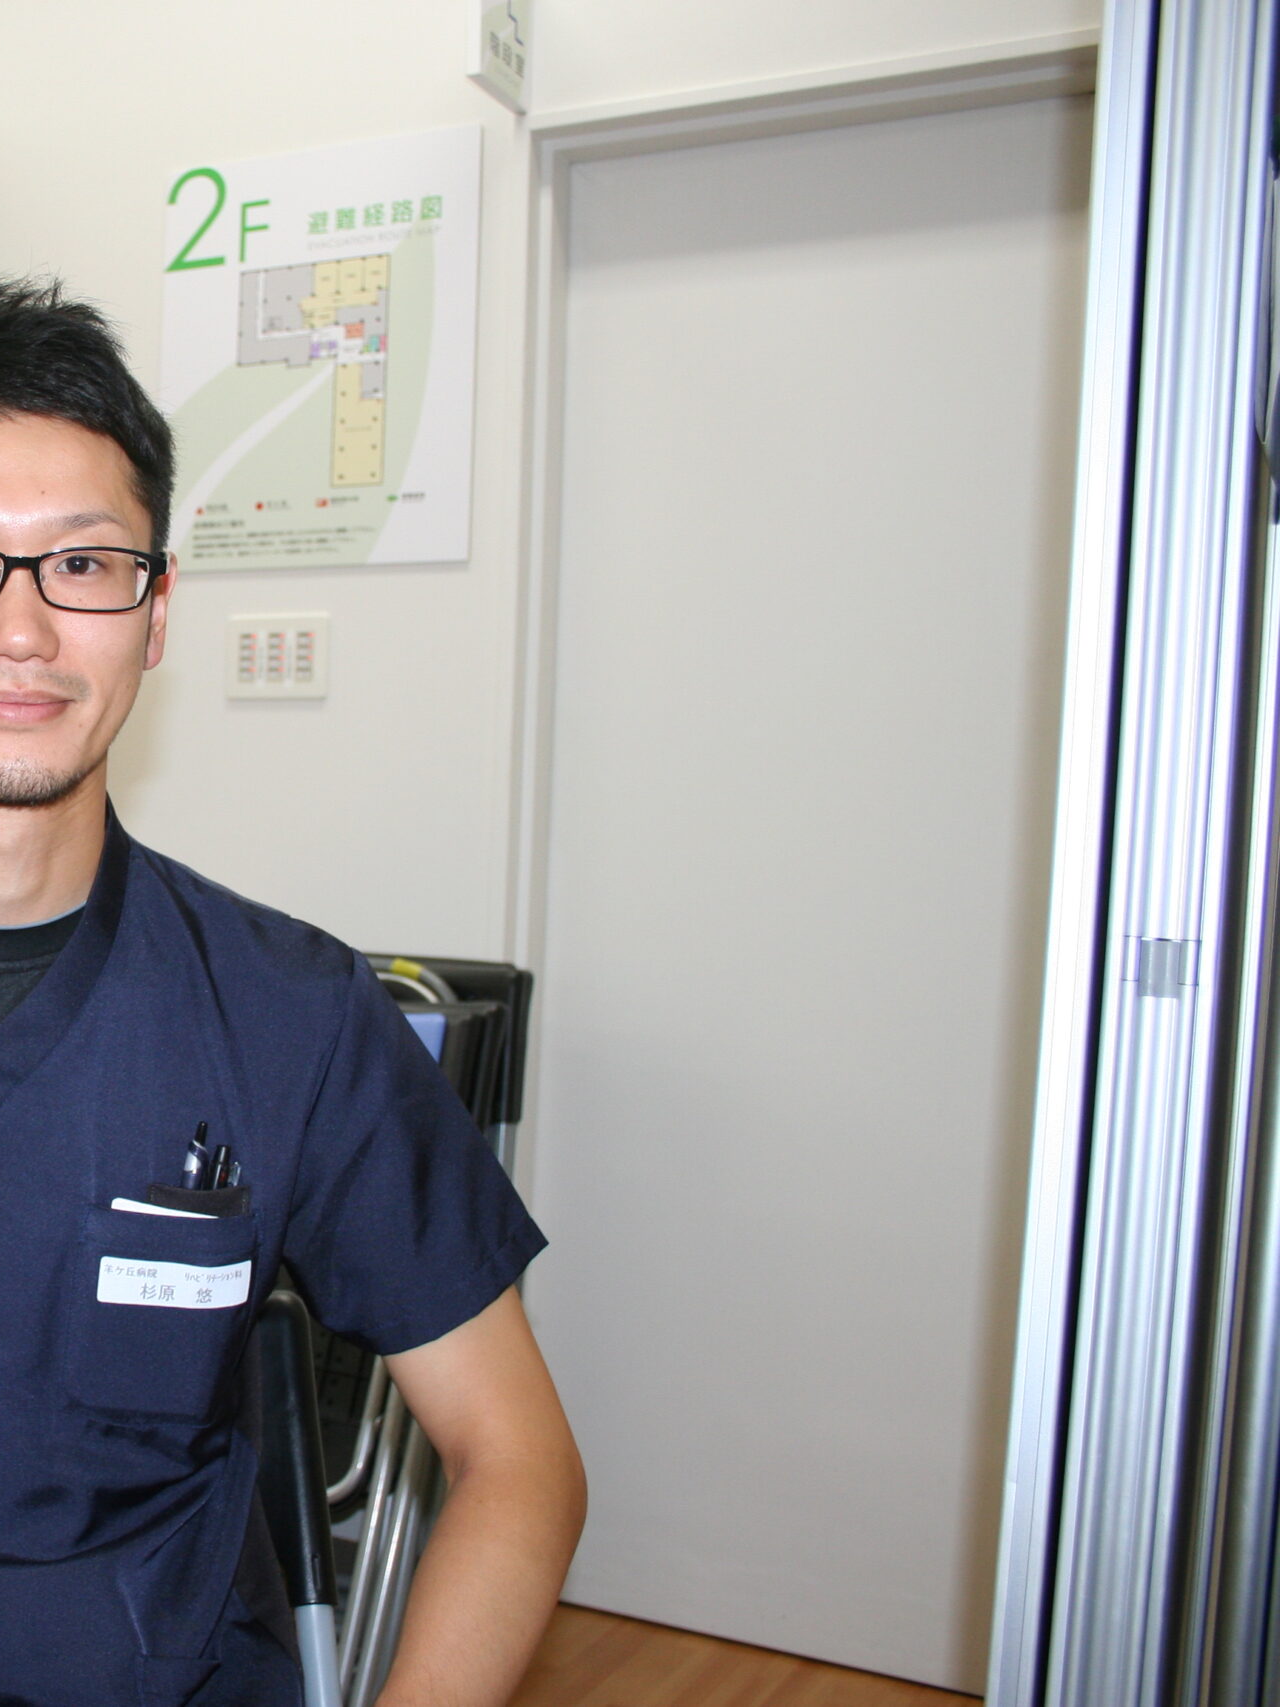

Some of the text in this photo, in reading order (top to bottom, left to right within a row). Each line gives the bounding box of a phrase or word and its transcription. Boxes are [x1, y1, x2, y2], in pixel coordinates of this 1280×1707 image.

[165, 167, 271, 272] 2F
[307, 195, 442, 234] 避難経路図
[140, 1283, 176, 1301] 杉原
